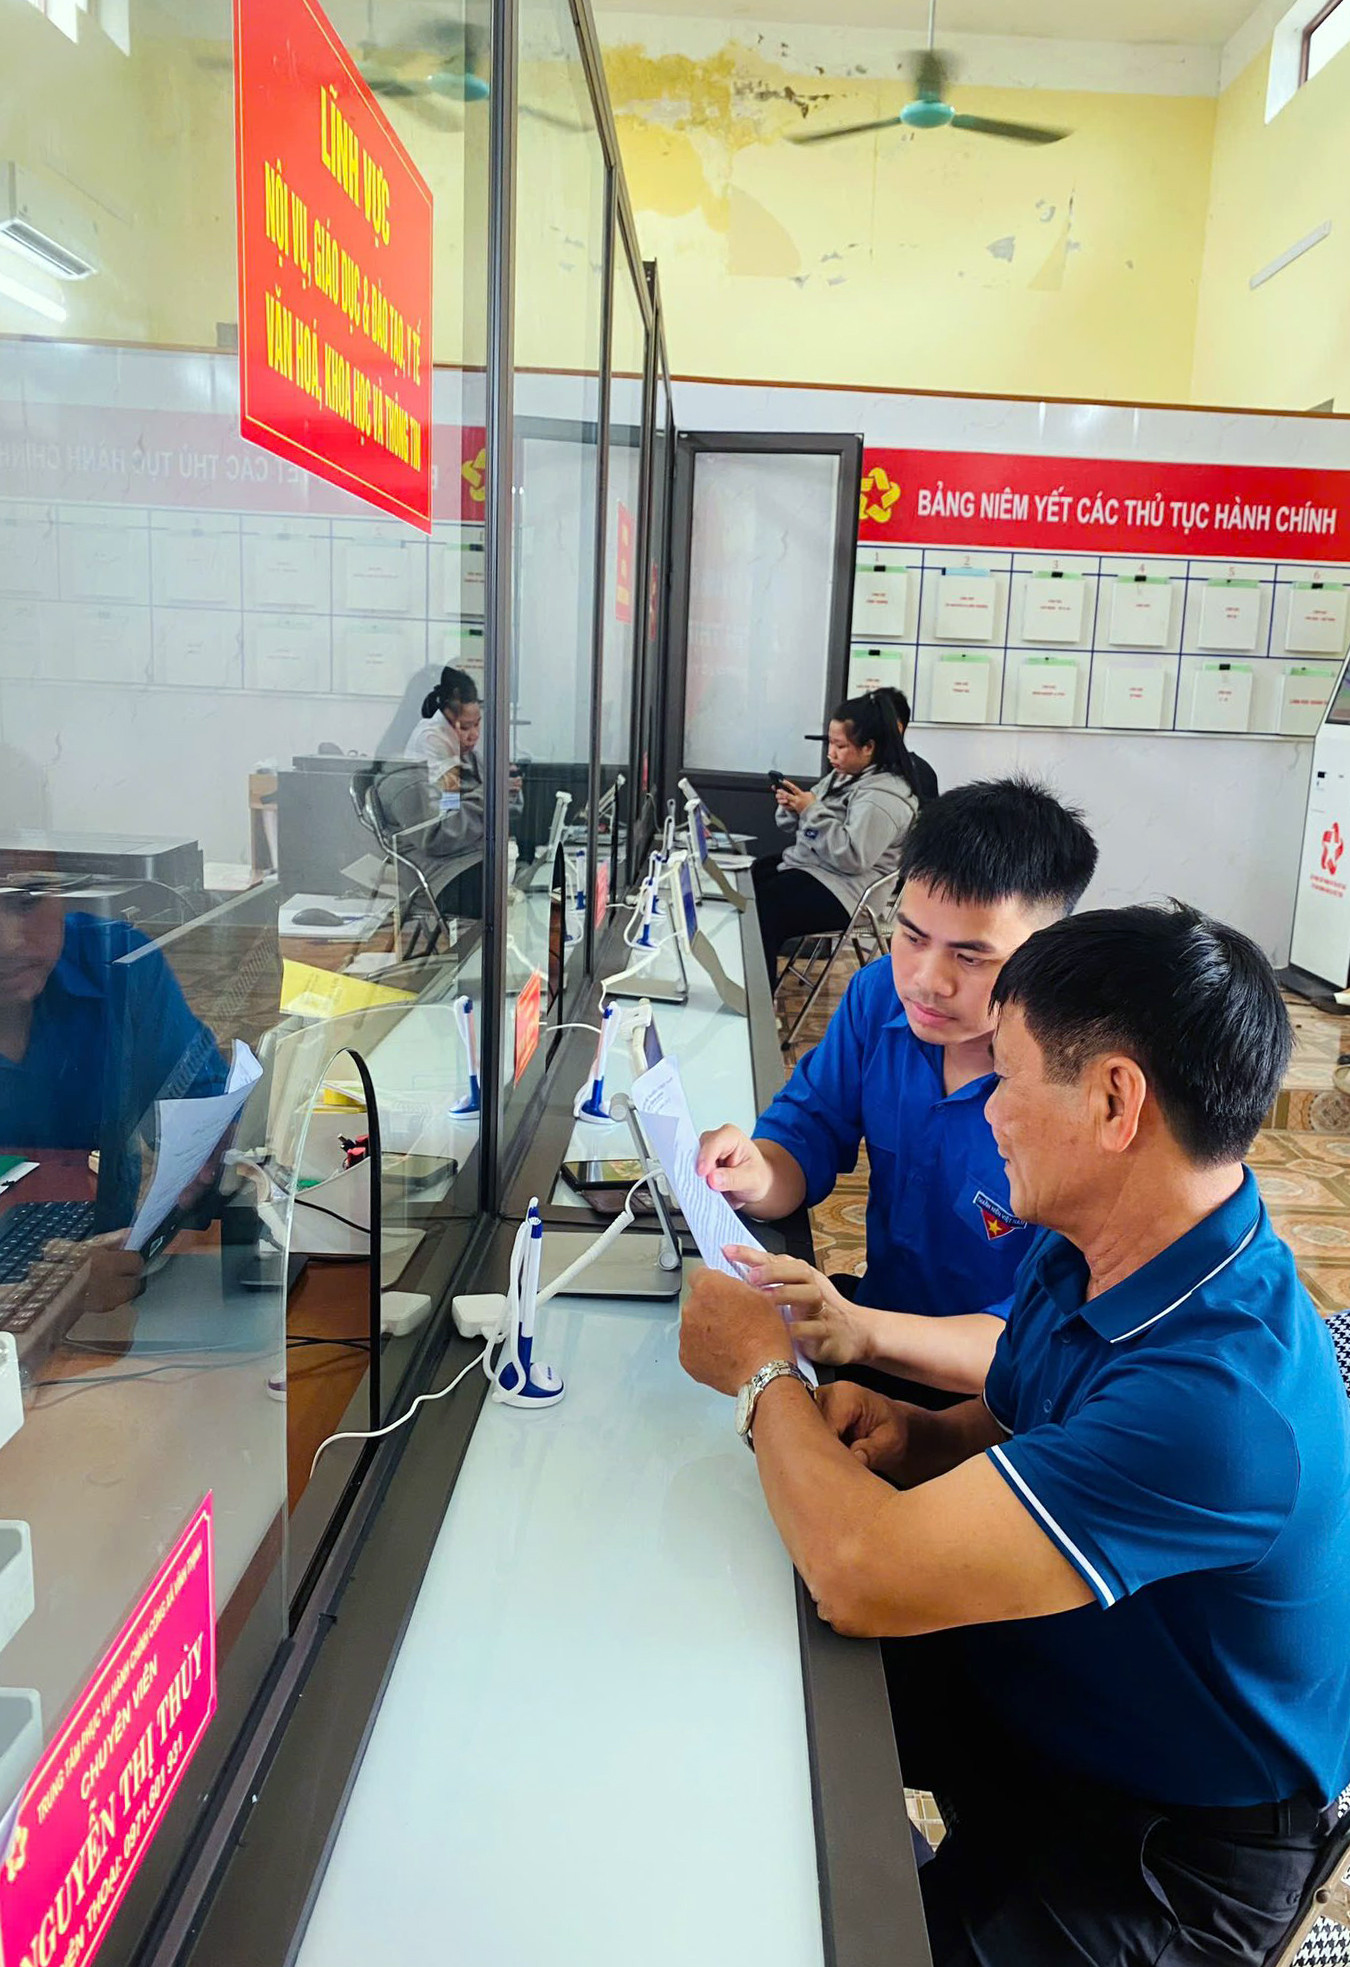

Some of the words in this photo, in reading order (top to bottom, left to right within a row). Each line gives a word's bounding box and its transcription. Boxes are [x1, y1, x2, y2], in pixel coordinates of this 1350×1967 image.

[320, 83, 360, 208] LĨNH
[363, 147, 390, 248] VỰC
[264, 157, 289, 267] NỘI
[313, 218, 339, 306] GIÁO
[341, 248, 360, 335] DỤC
[362, 275, 370, 336] &
[265, 282, 293, 382] VĂN
[324, 342, 353, 424] KHOA
[353, 366, 372, 446] HỌC
[373, 376, 384, 447] VÀ
[917, 480, 975, 518] BẢNG
[980, 484, 1029, 521] NIÊM
[1033, 484, 1073, 525] YẾT
[1076, 490, 1119, 527] CÁC
[1124, 492, 1166, 529] THỦ
[1170, 501, 1210, 536] TỤC
[1214, 496, 1270, 532] HÀNH
[1275, 499, 1337, 535] CHÍNH
[80, 1698, 130, 1800] CHUYÊN
[133, 1653, 158, 1709] VIÊN
[119, 1721, 154, 1816] THỊ
